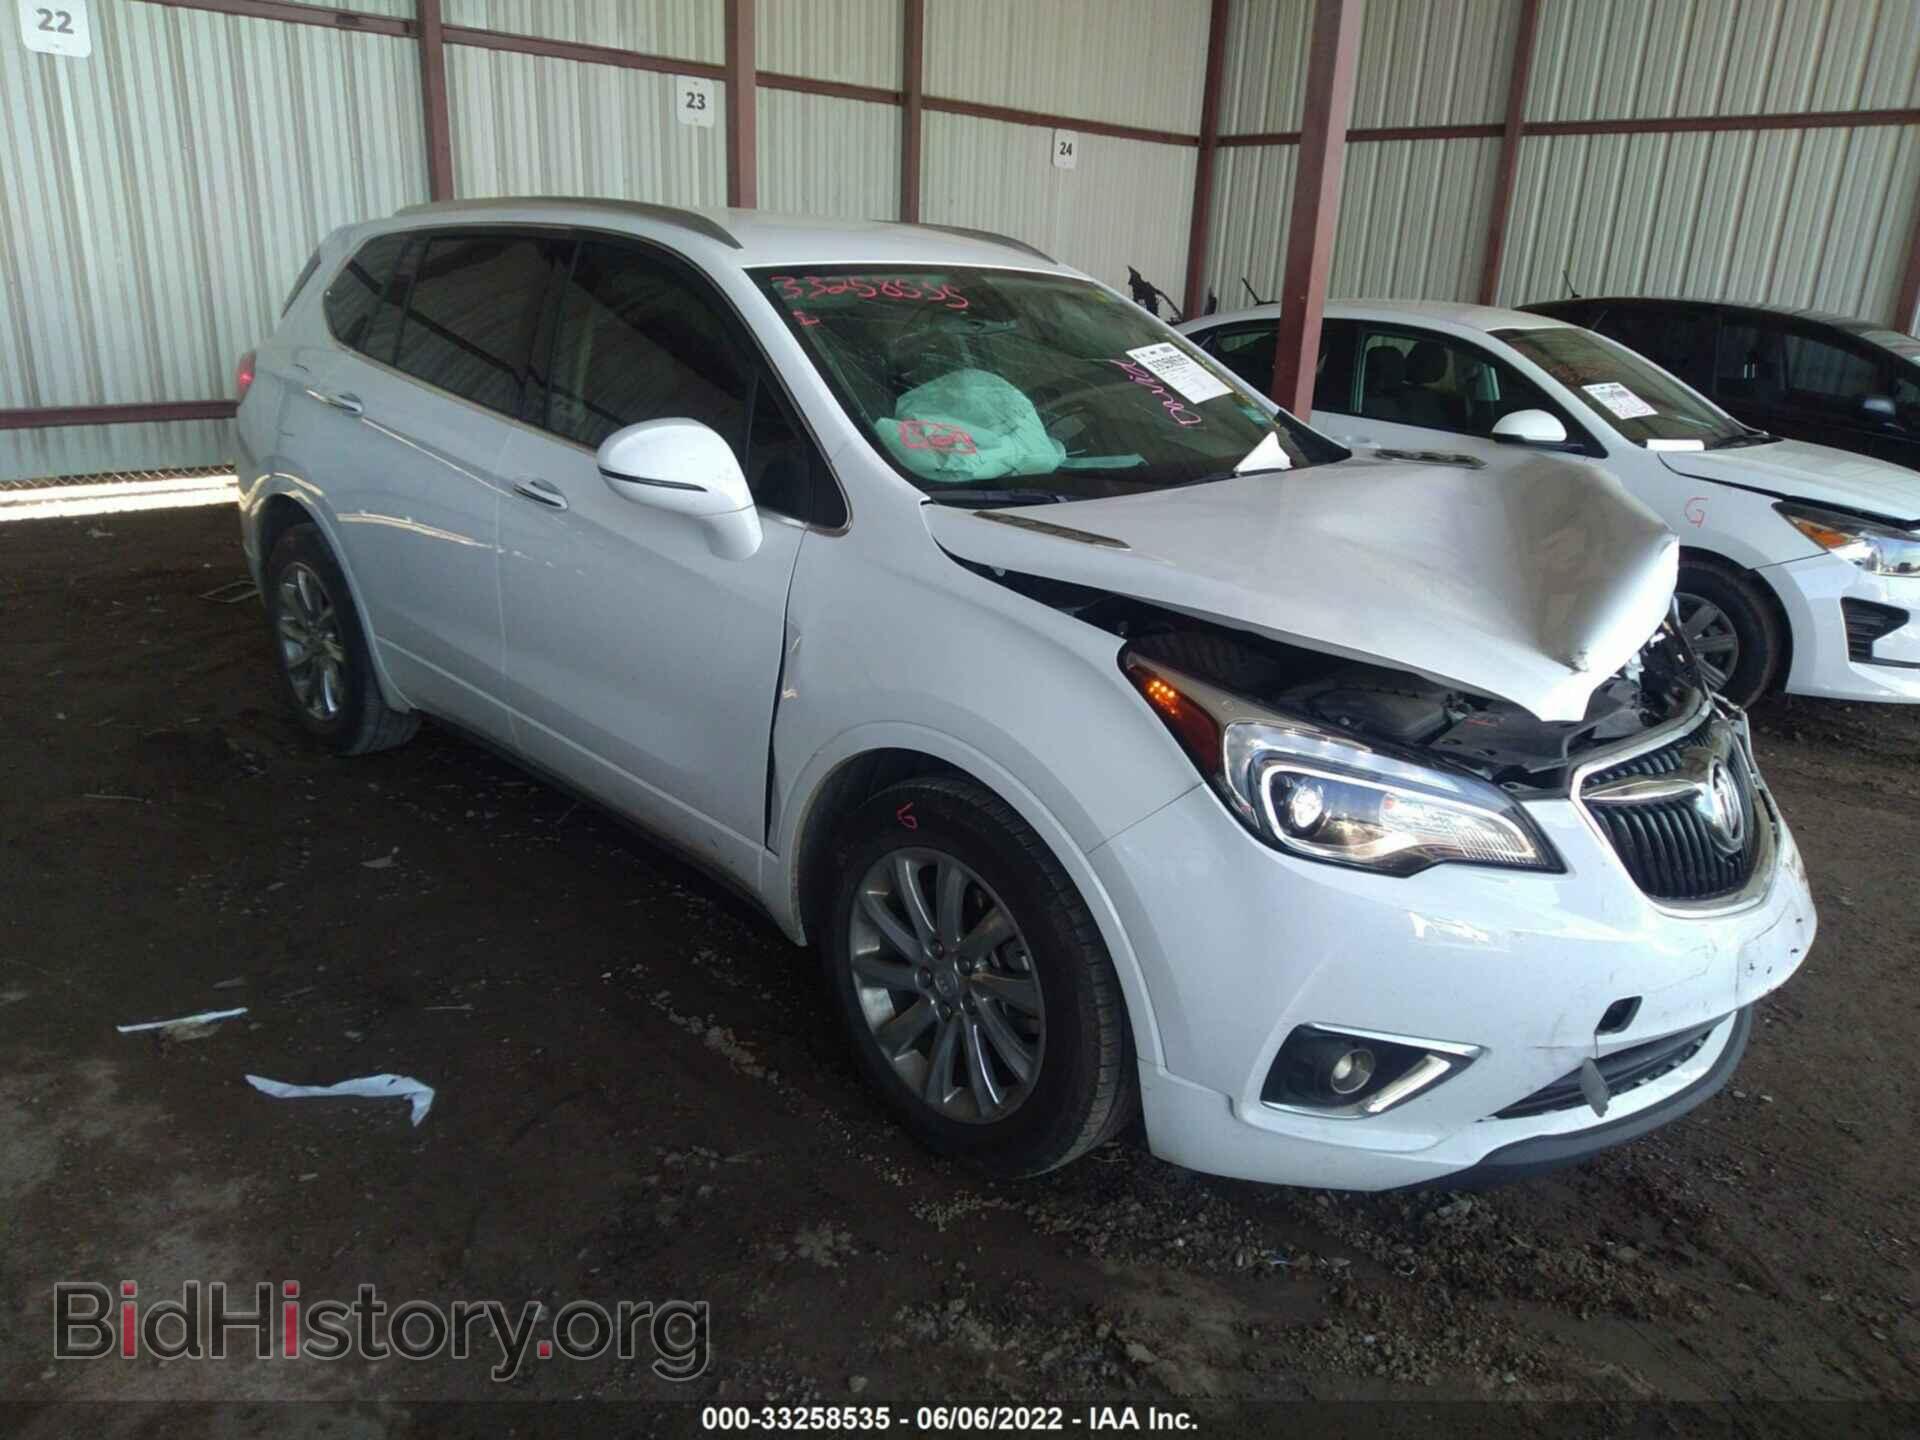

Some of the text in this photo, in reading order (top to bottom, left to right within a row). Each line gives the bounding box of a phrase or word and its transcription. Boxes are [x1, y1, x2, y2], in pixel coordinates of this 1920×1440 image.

[36, 8, 74, 34] 22
[686, 91, 706, 110] 23
[1059, 141, 1073, 156] 24
[1684, 497, 1709, 528] G
